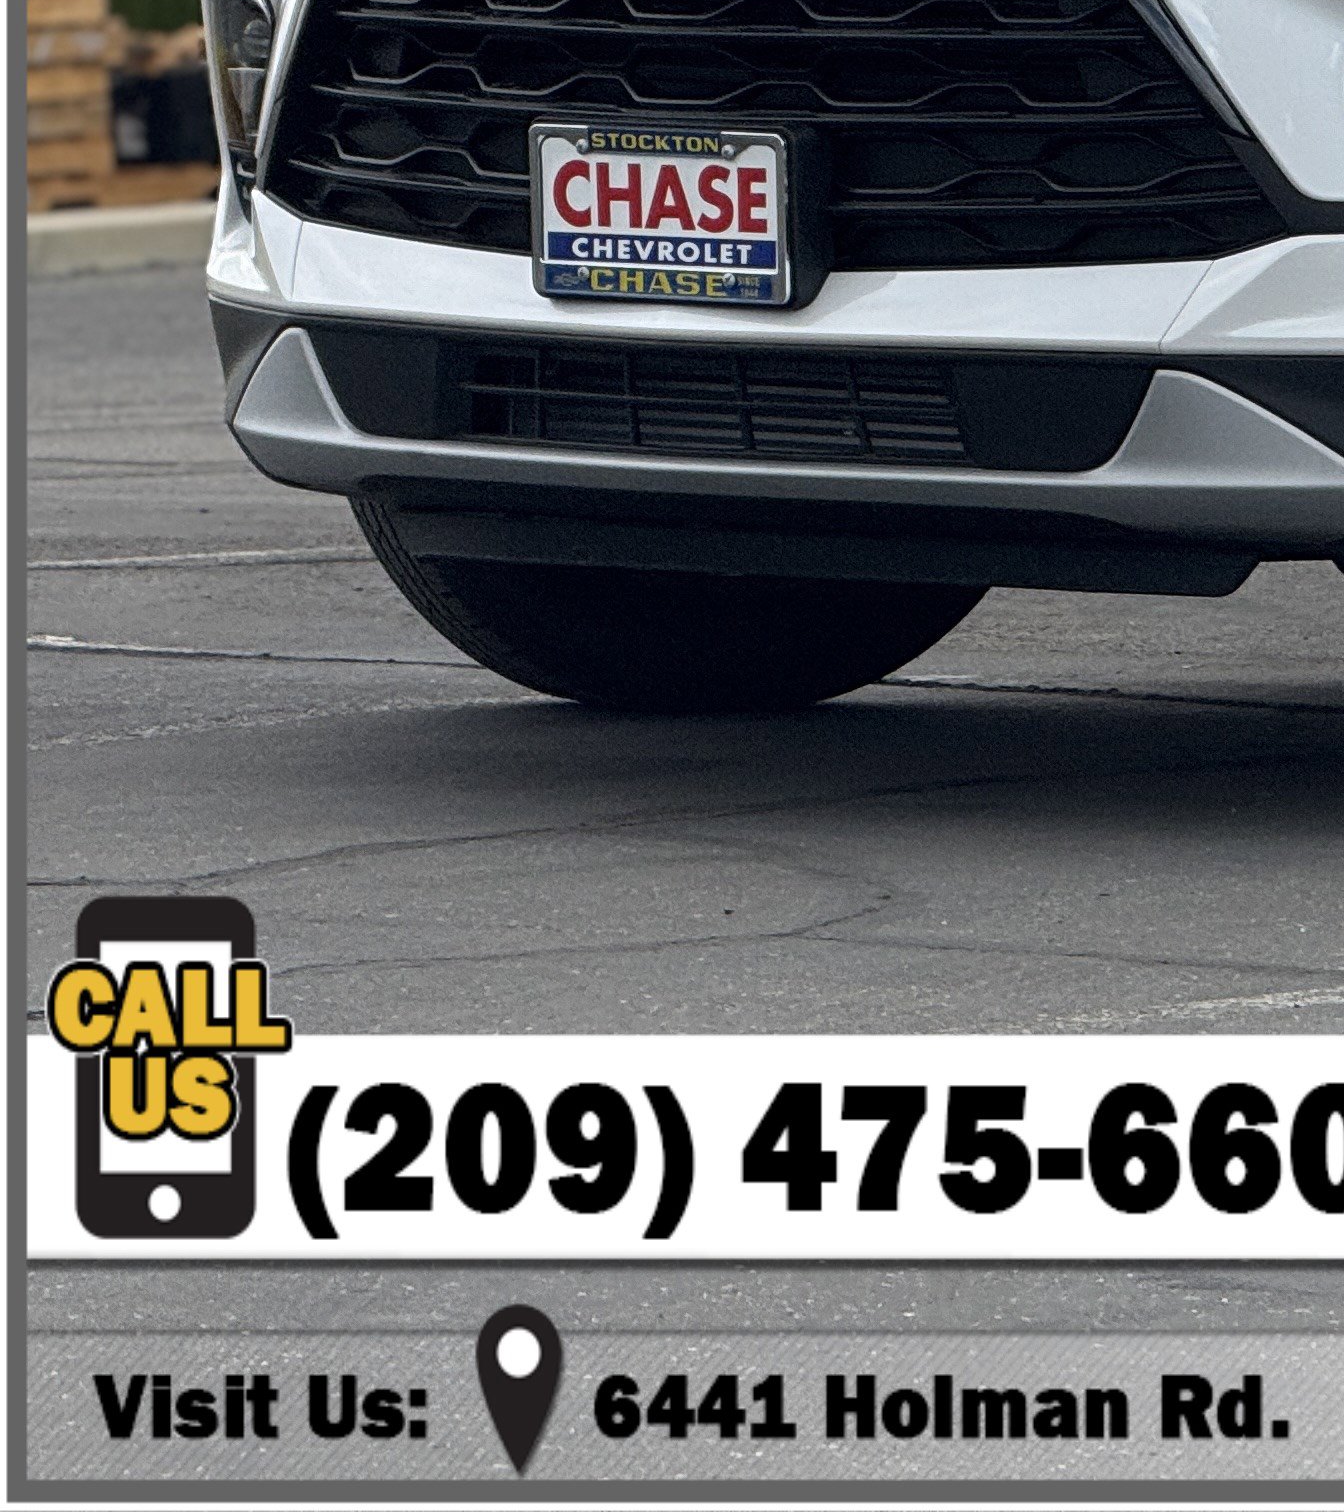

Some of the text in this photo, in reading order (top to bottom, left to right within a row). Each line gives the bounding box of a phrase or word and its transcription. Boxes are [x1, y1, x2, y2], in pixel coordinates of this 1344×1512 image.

[590, 132, 719, 154] STOCKTON
[553, 159, 768, 234] CHASE
[571, 237, 752, 265] CHEVROLET
[589, 268, 729, 298] CHASE
